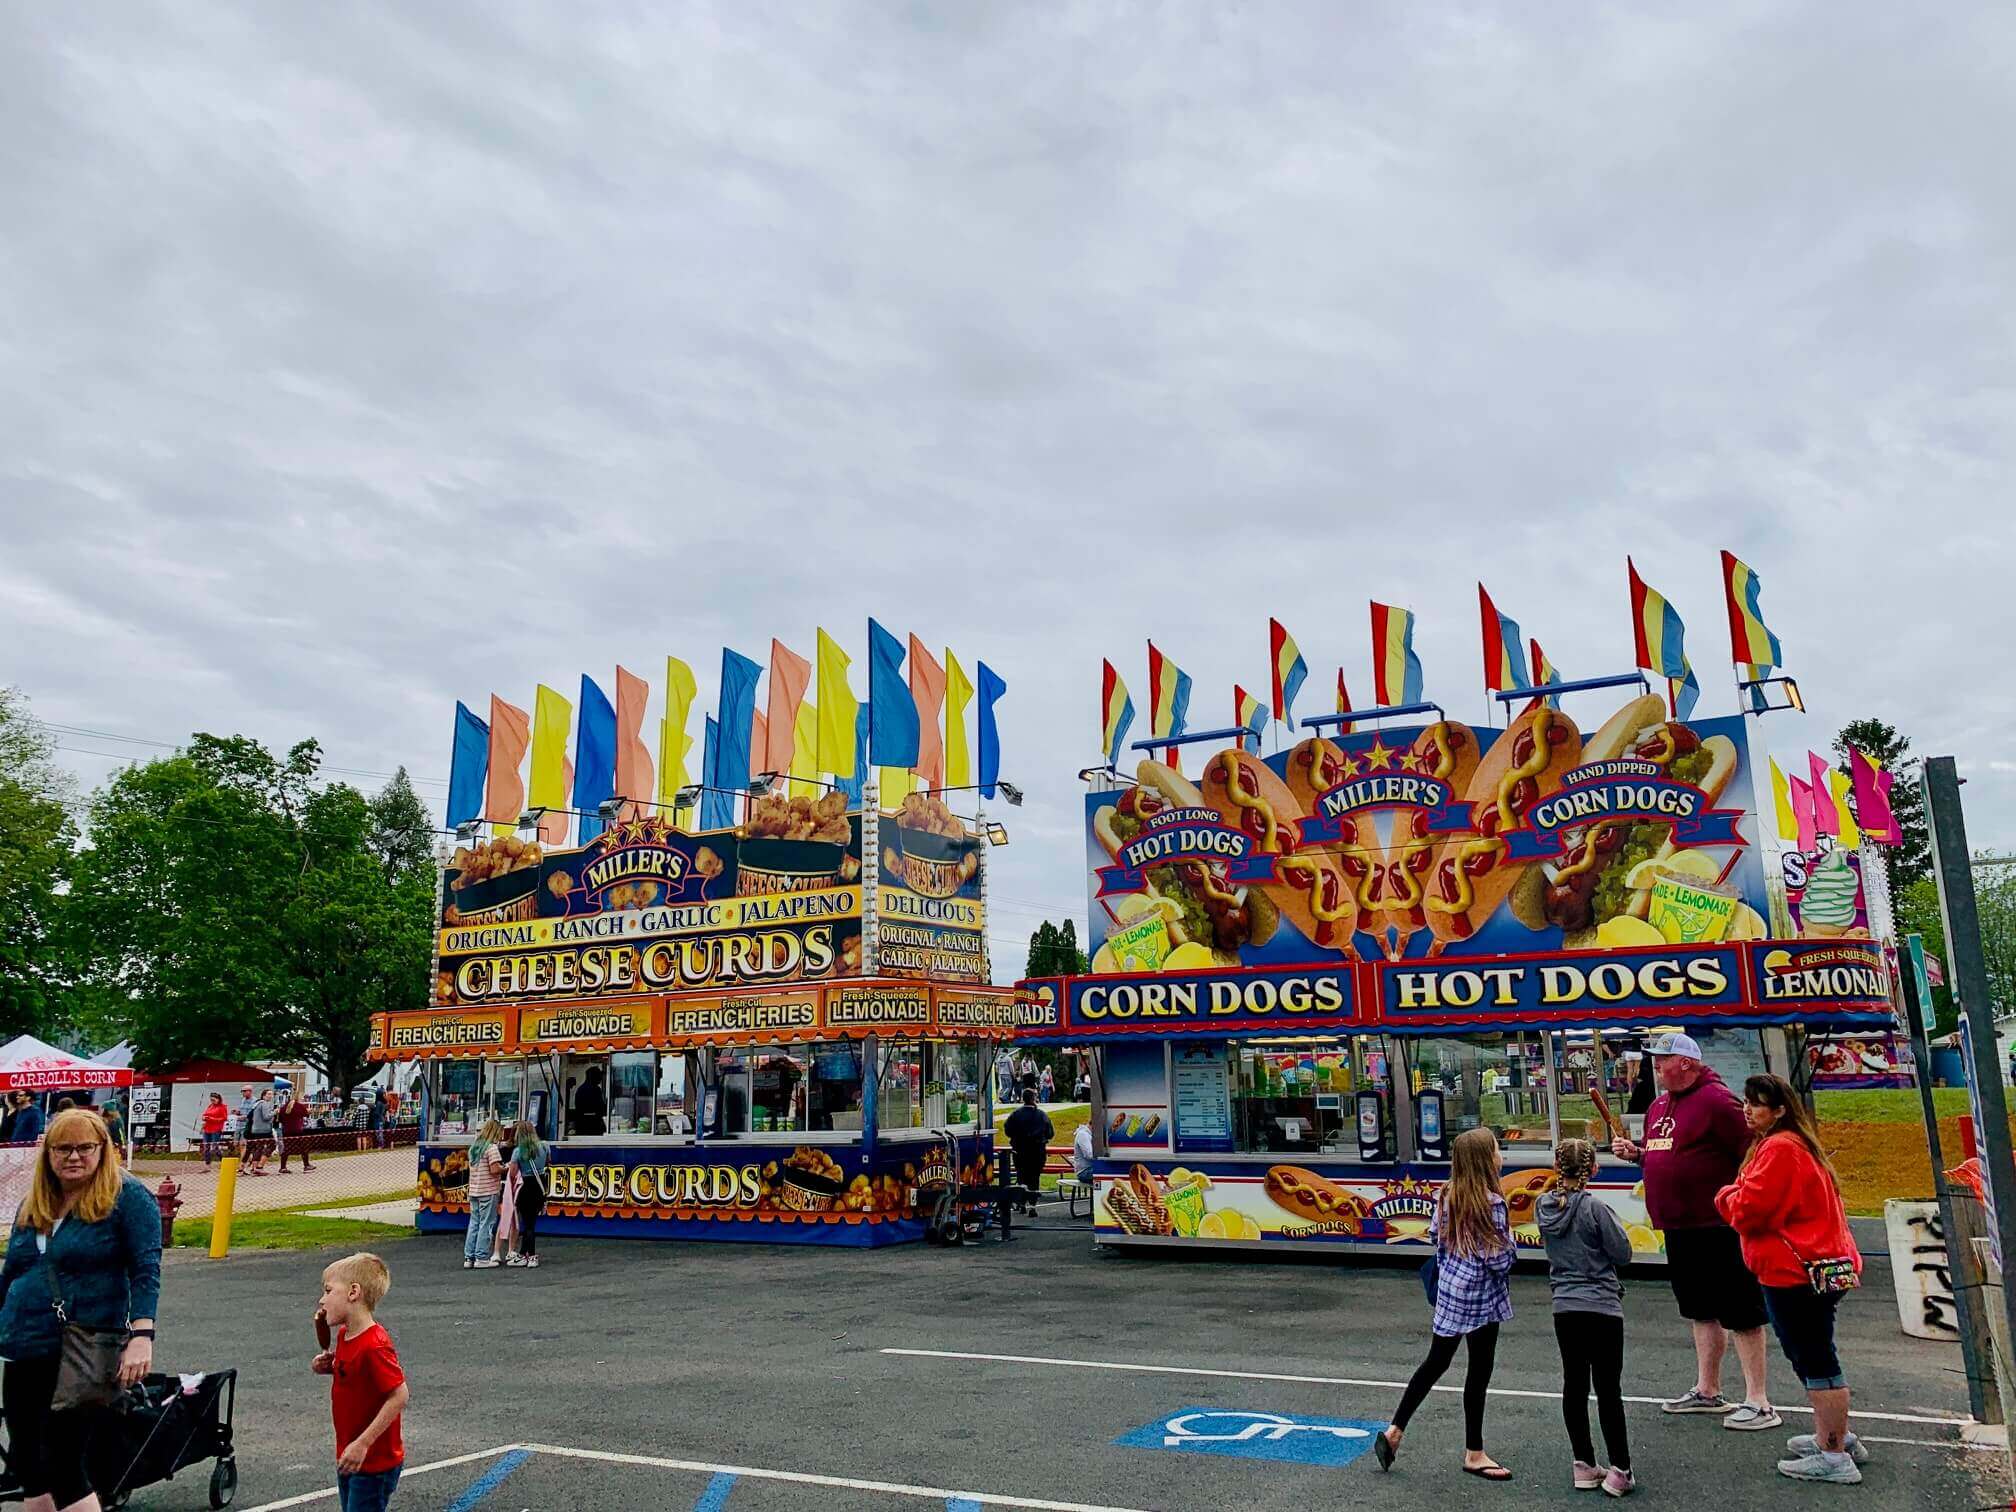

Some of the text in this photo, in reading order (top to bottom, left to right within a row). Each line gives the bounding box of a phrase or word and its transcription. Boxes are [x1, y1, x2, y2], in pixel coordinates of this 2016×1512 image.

[1567, 761, 1657, 785] HAND DIPPED
[1323, 778, 1441, 819] MILLER'S
[1536, 785, 1695, 829] CORN DOGS
[1150, 810, 1219, 829] FOOT LONG
[1127, 829, 1245, 868] HOT DOGS
[588, 851, 683, 890] MILLER'S
[446, 891, 855, 951] ORIGINAL RANCH GARLIC JALAPENO
[884, 893, 976, 924] DELICIOUS
[880, 924, 979, 953] ORIGINAL RANCH
[456, 926, 835, 1002] CHEESE CURDS
[880, 947, 981, 976] GARLIC JALAPENO
[1800, 949, 1879, 967] FRESH SQUEEZED
[1080, 976, 1344, 1018] CORN DOGS
[1396, 958, 1728, 1008] HOT DOGS
[672, 1003, 814, 1031] FRENCH FRIES
[831, 1000, 927, 1021] LEMONADE
[937, 1002, 993, 1024] FRENCH
[391, 1021, 502, 1046] FRENCH FRIES
[538, 1015, 632, 1037] LEMONADE
[10, 1071, 117, 1087] CARROLL'S CORN
[629, 1164, 761, 1206] CURDS
[1280, 1219, 1351, 1240] CORN DOGS
